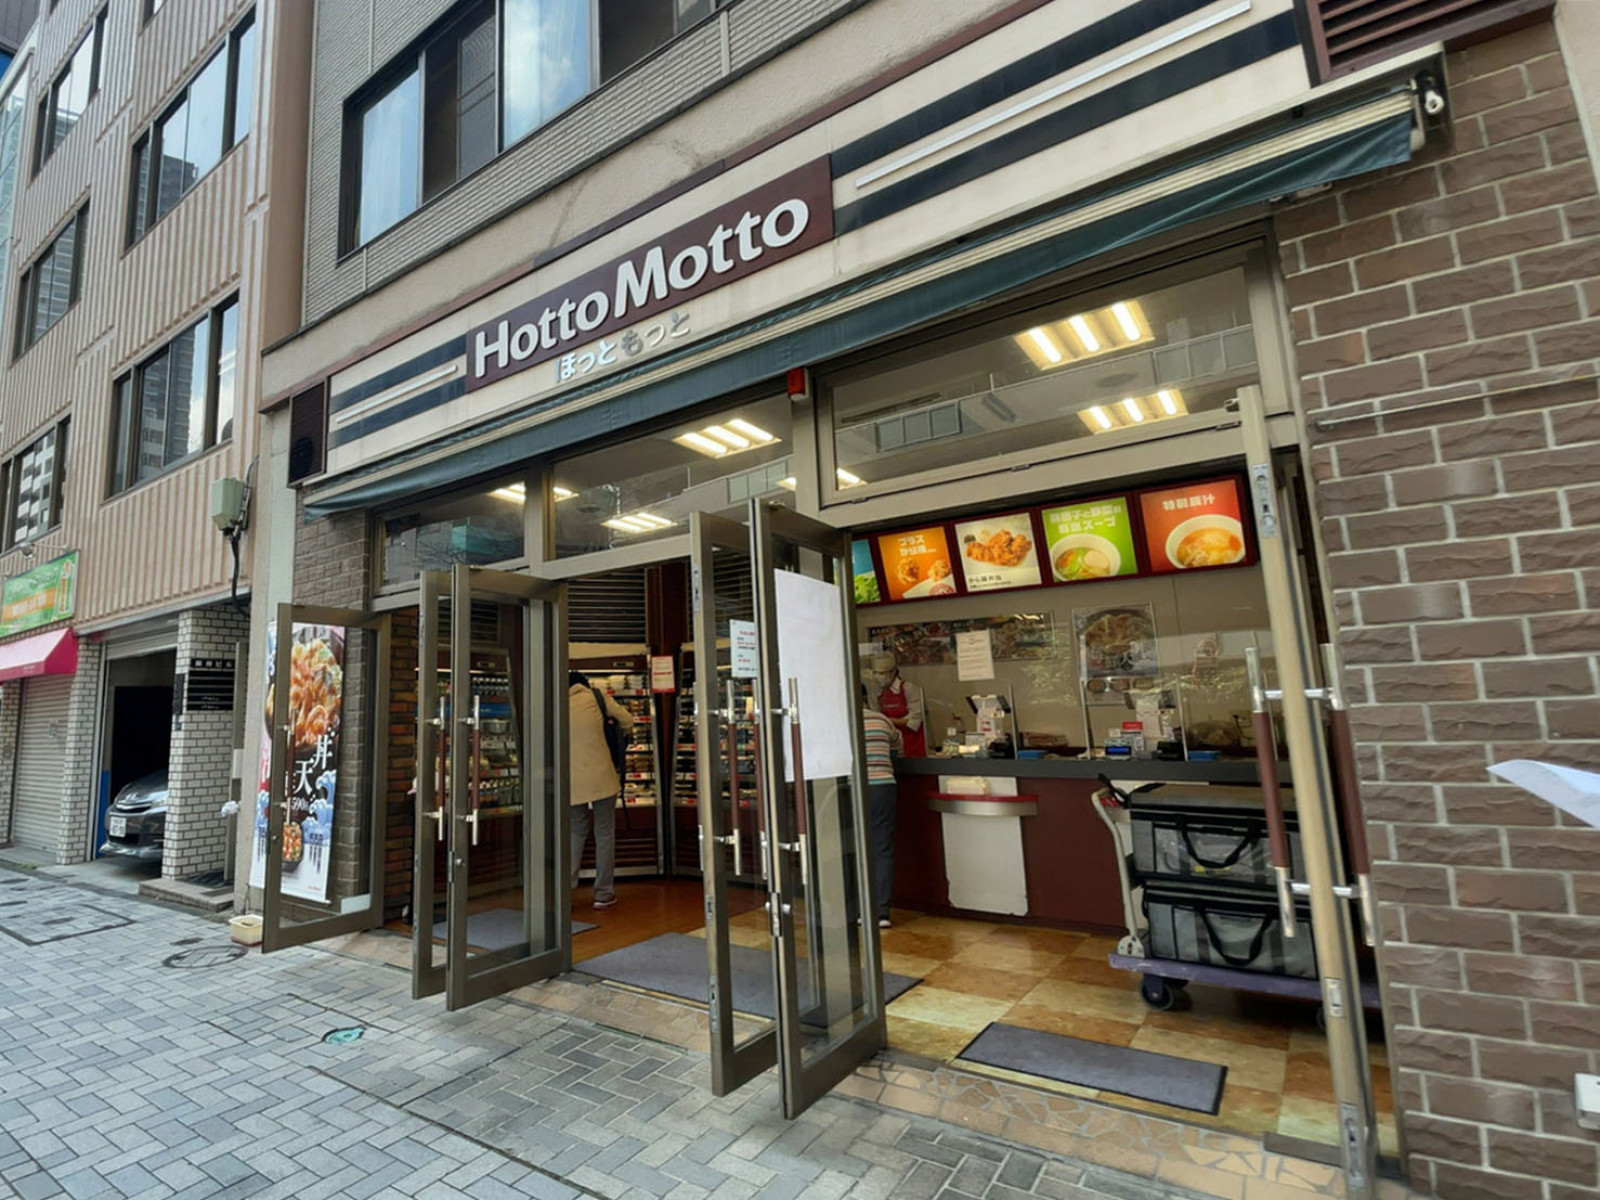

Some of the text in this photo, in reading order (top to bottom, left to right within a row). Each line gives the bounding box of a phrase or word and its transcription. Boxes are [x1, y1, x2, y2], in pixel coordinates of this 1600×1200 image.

[555, 311, 691, 382] ほっともっと
